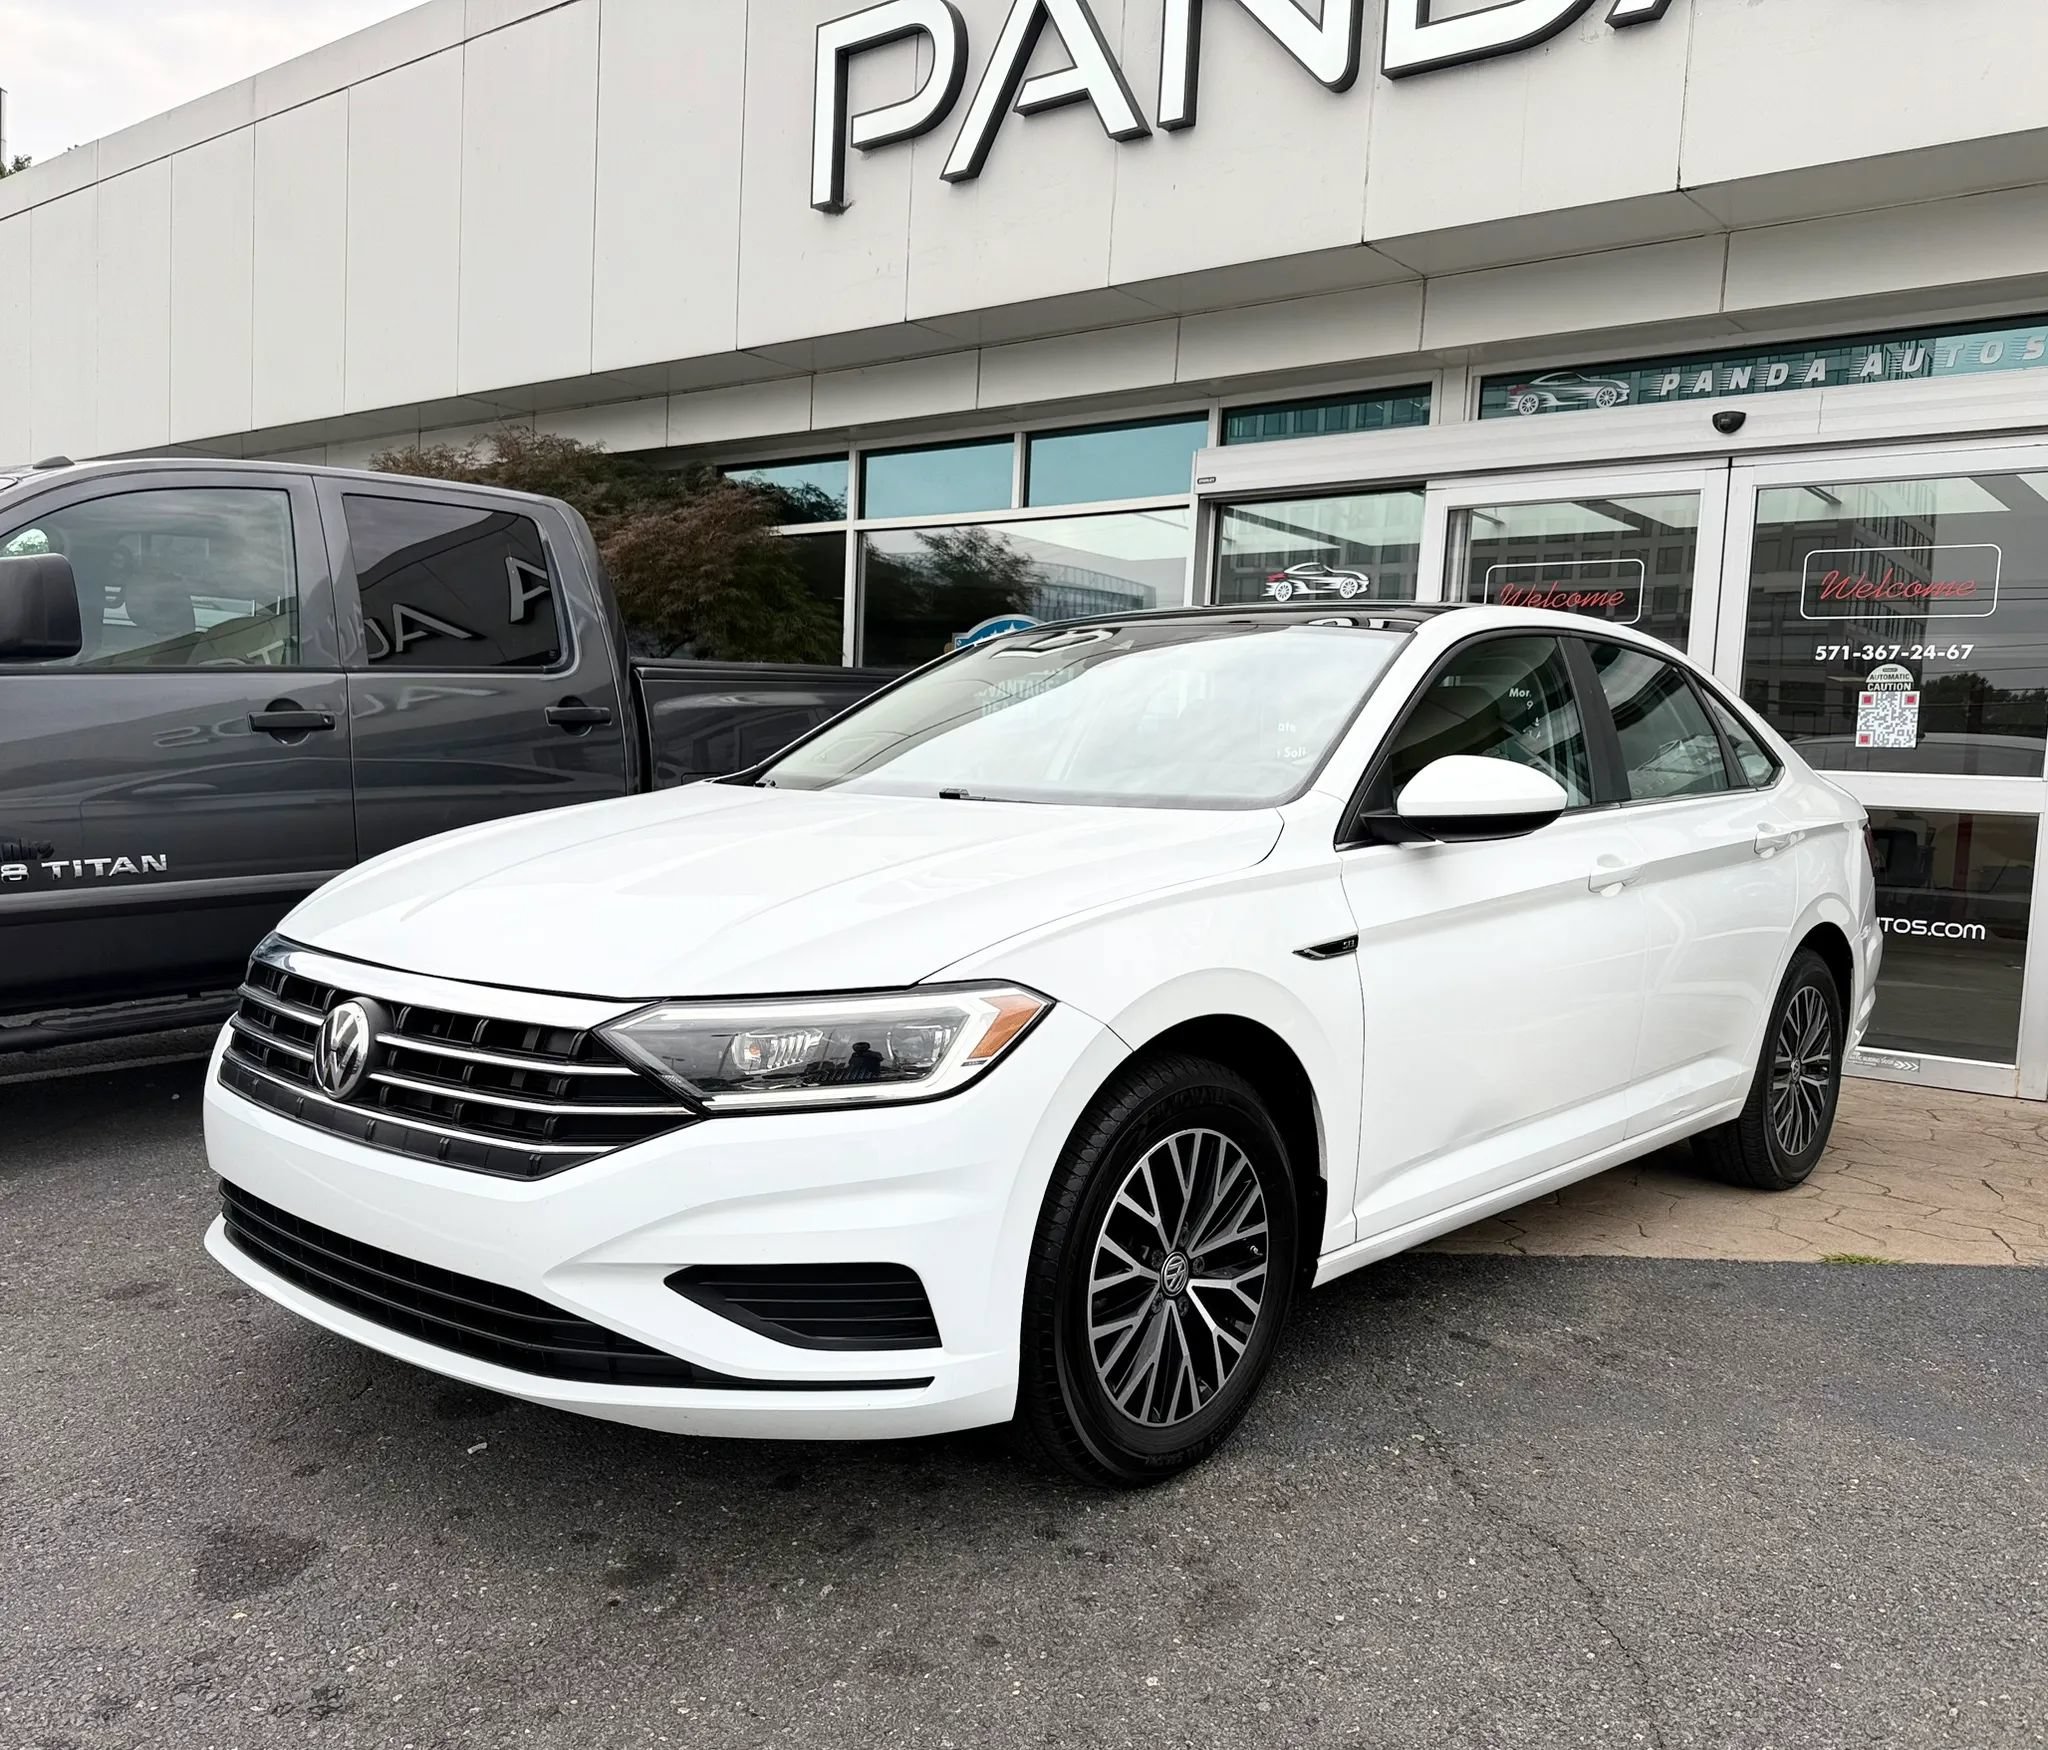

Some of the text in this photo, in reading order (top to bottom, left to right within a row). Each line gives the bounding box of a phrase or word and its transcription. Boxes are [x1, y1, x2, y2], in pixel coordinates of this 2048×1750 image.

[810, 0, 1672, 212] PAN
[1657, 335, 2048, 397] PANDA AUTOS
[1500, 580, 1626, 609] Welcome
[1820, 567, 1977, 601] Welcome
[1814, 643, 1975, 661] 571-367-24-67
[1867, 682, 1912, 691] CAUTION
[1869, 673, 1911, 681] AUTOMATIC
[41, 853, 168, 881] TITAN
[1876, 917, 1986, 941] TOS.com
